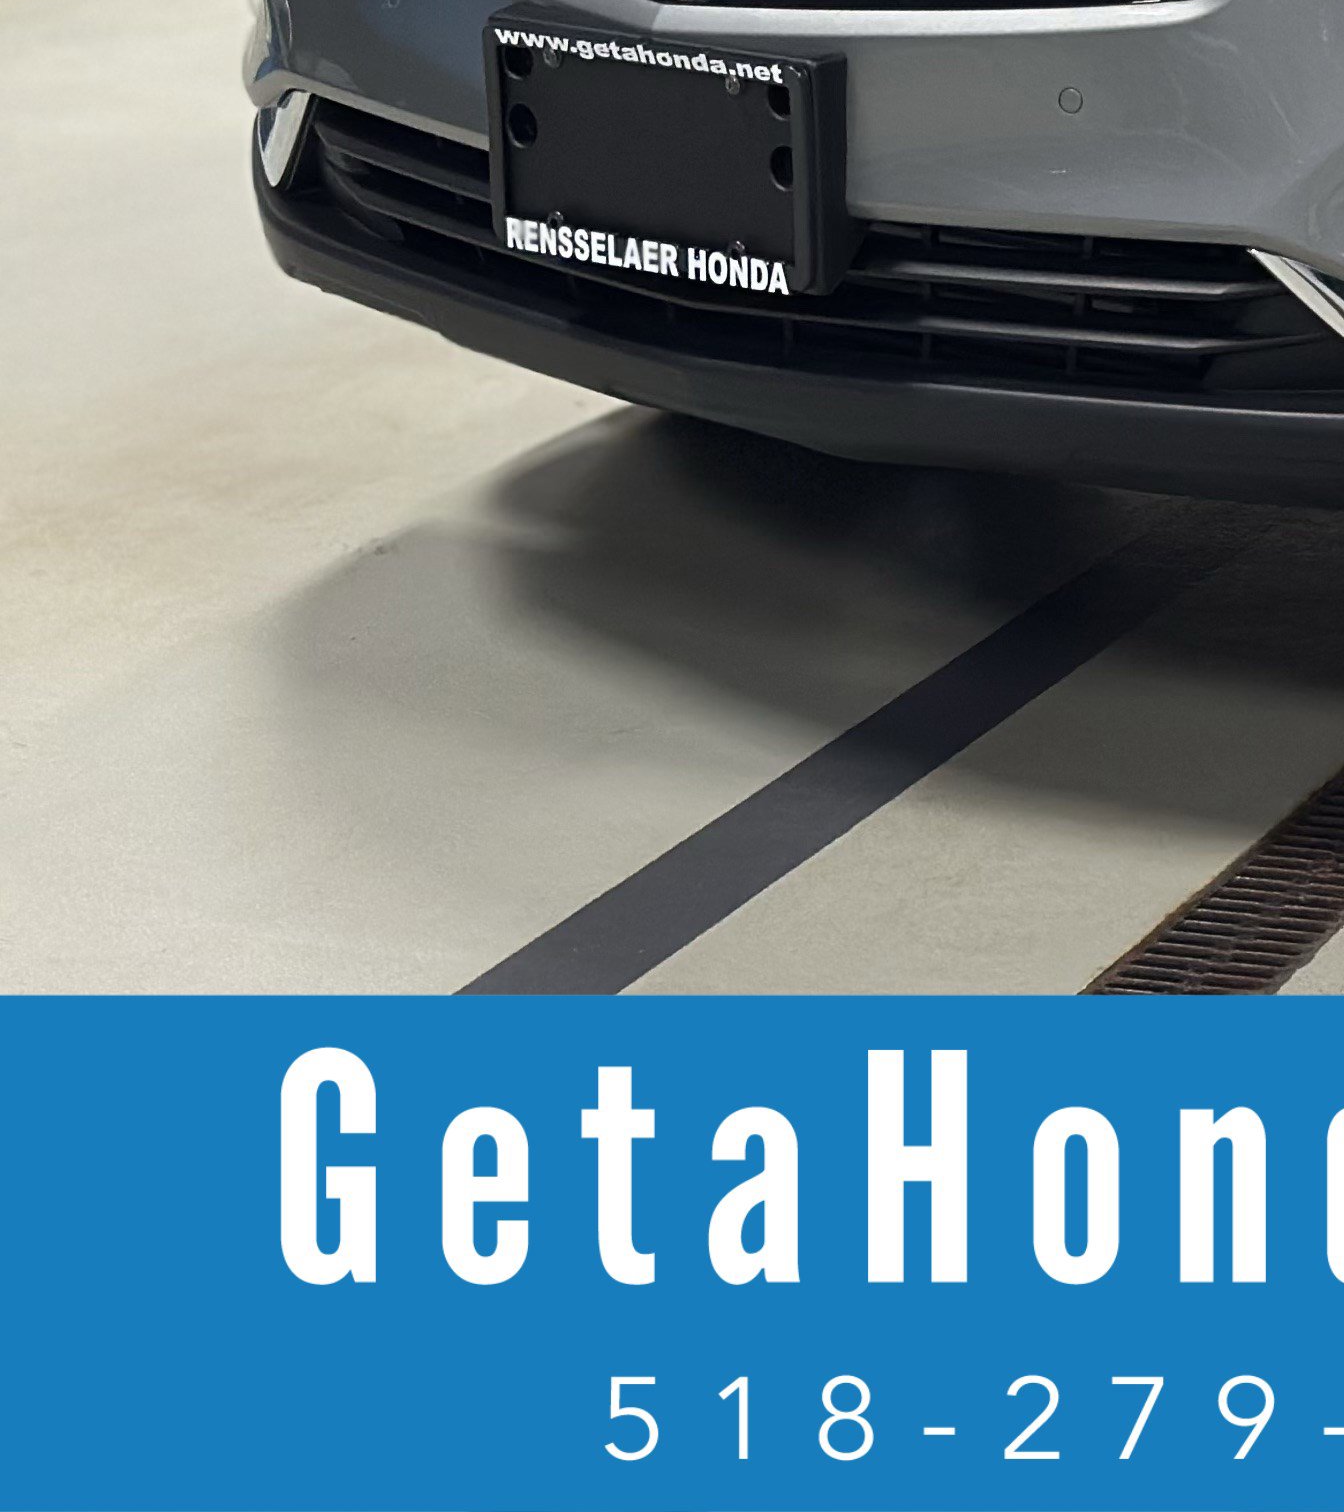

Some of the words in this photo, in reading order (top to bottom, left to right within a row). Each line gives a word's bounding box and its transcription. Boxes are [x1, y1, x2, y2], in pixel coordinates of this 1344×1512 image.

[494, 27, 784, 84] www.getahonda.net
[505, 216, 679, 277] RENSSELAER
[687, 247, 790, 296] HONDA
